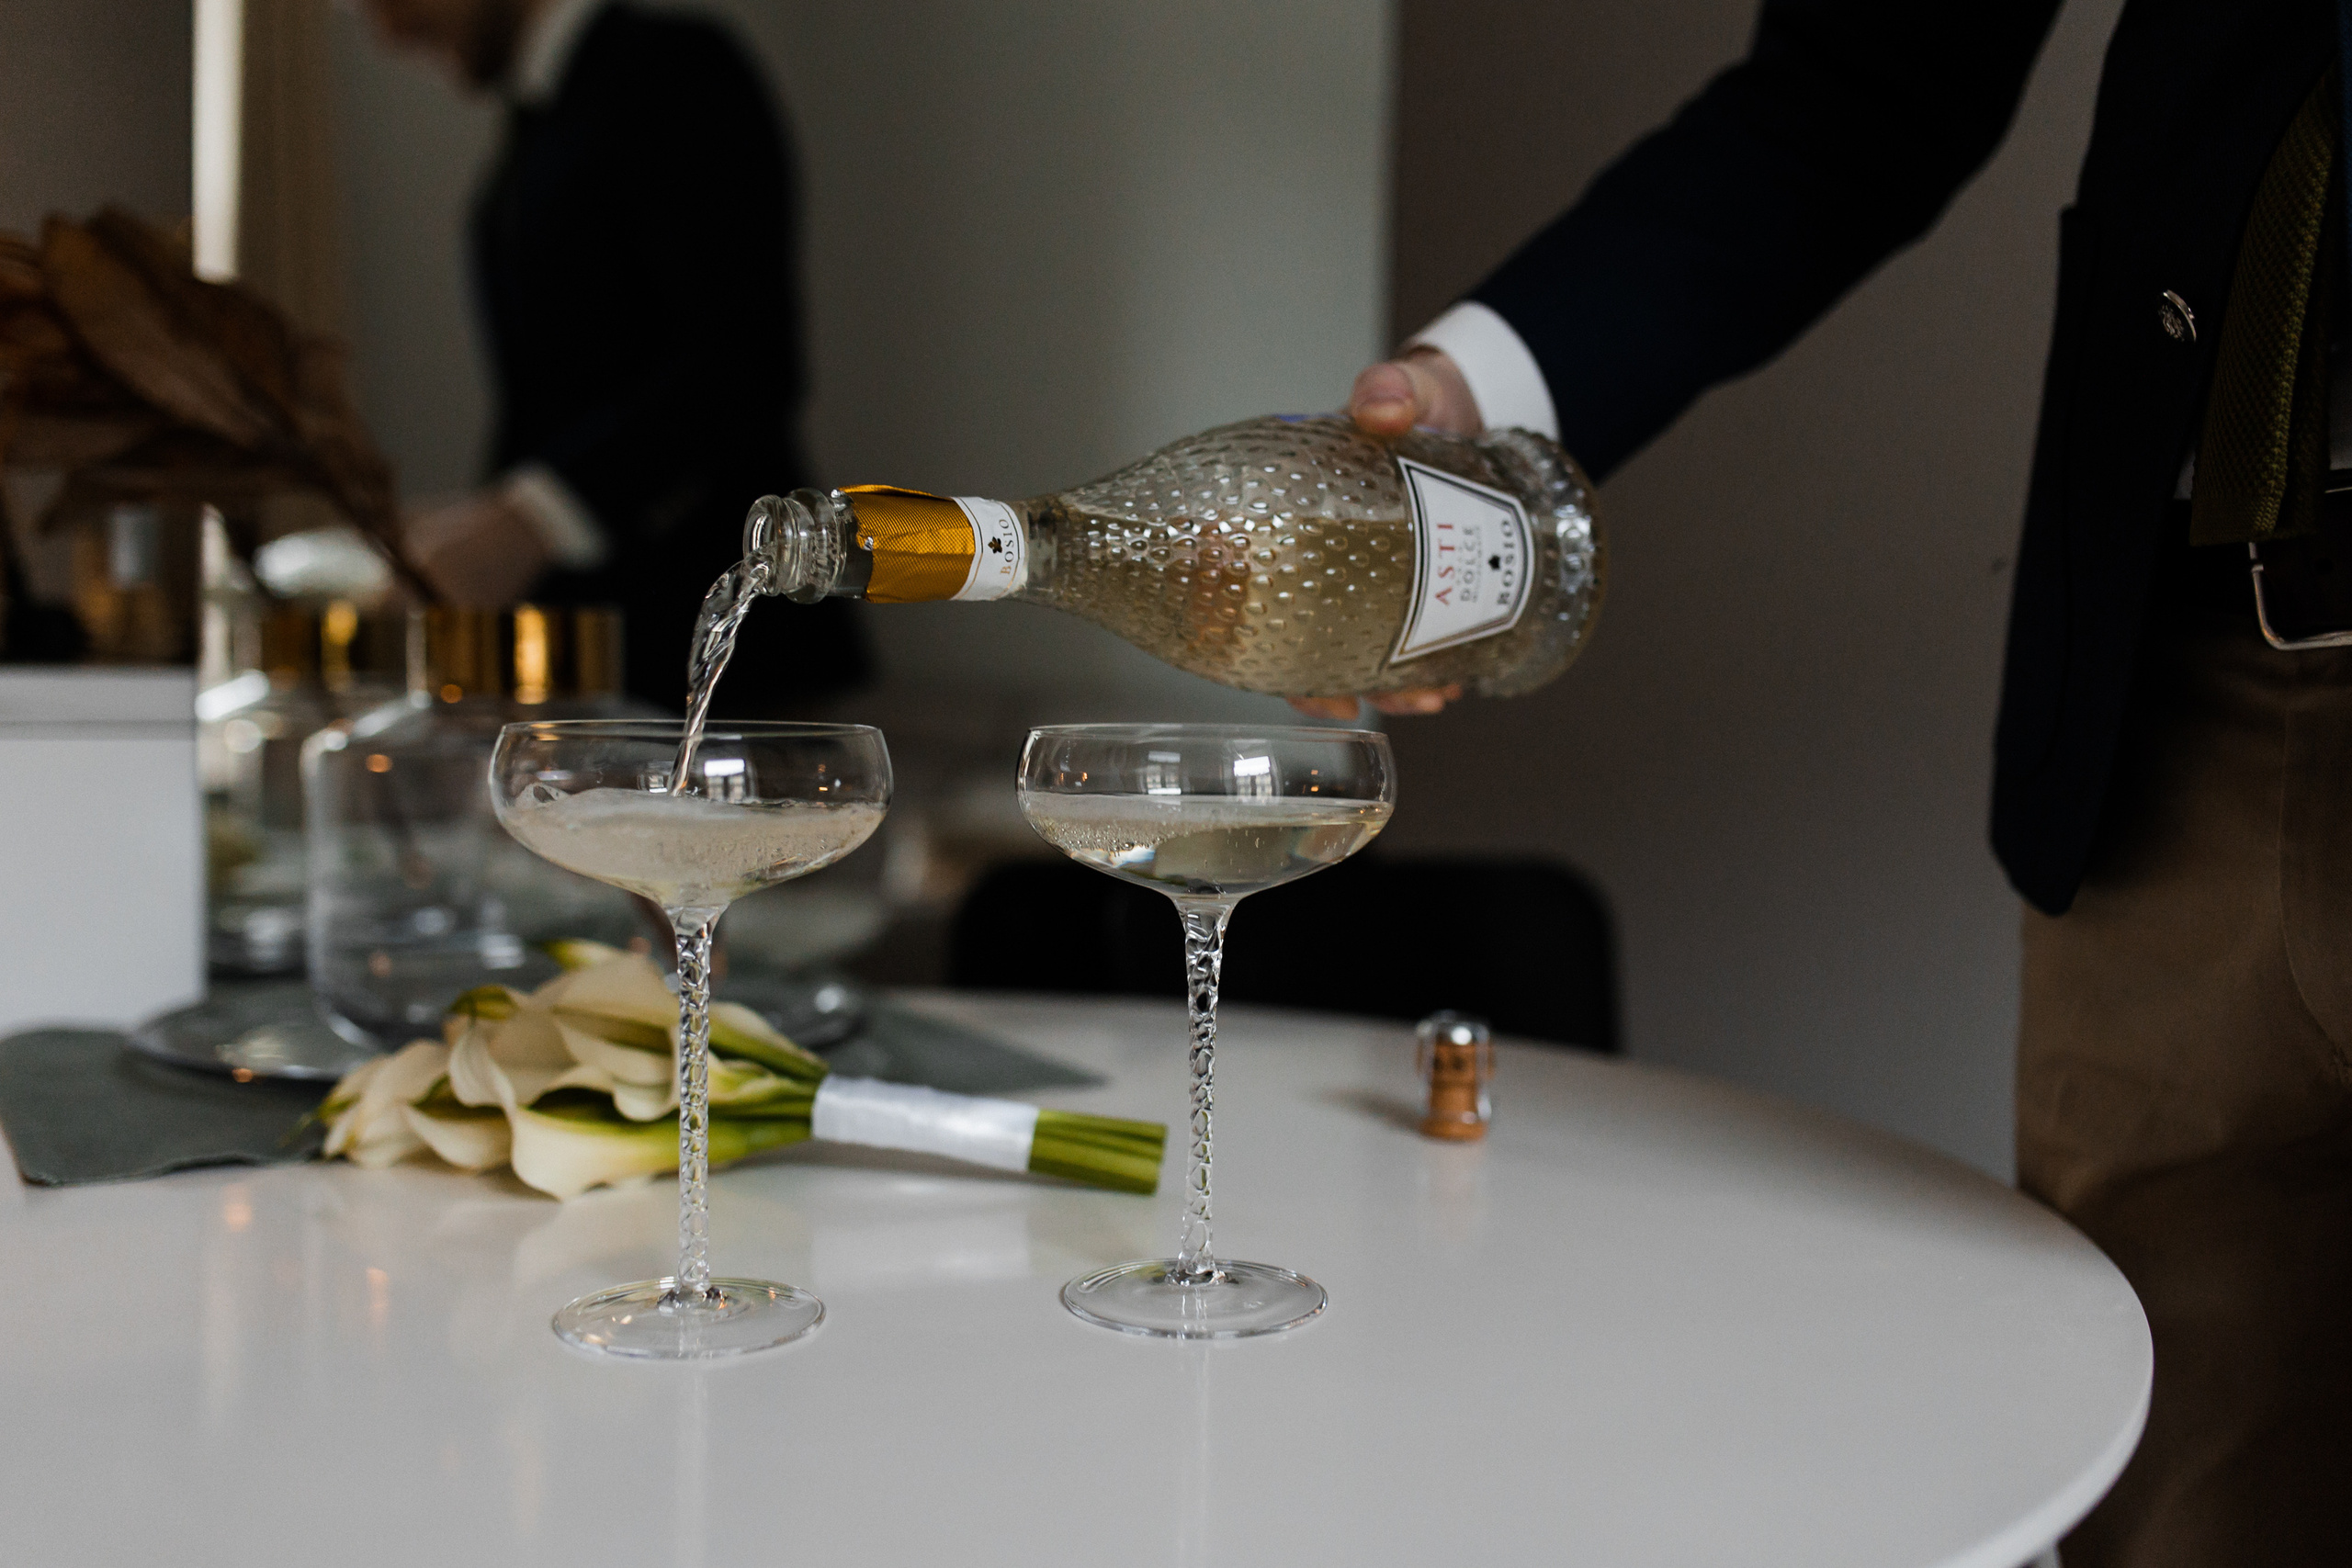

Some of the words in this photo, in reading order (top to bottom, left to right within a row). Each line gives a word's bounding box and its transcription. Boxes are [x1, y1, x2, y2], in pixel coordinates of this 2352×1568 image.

[999, 519, 1014, 574] BOSIO
[1435, 524, 1454, 606] ASTI
[1498, 520, 1515, 604] BOSIO
